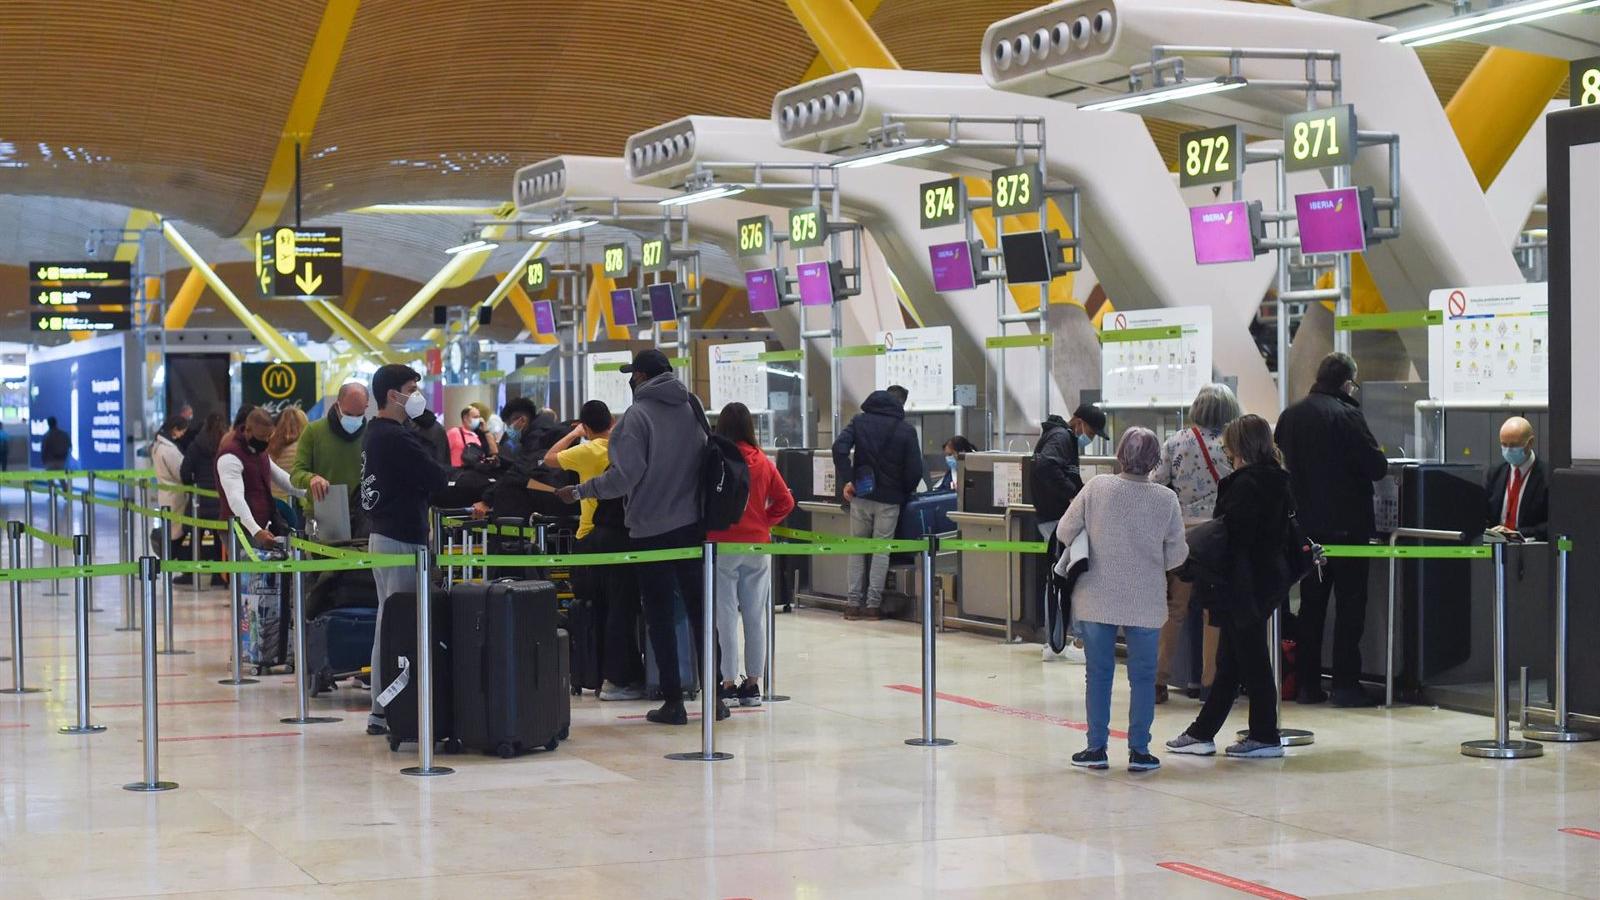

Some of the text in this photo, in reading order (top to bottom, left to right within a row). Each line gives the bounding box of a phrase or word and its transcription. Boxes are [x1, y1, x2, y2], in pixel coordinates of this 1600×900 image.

[1293, 116, 1339, 160] 871
[1186, 135, 1230, 176] 872
[925, 186, 955, 219] 874
[996, 173, 1030, 207] 873
[1202, 212, 1225, 224] IBERIA
[1309, 199, 1334, 211] IBERIA
[740, 222, 763, 250] 876
[792, 212, 817, 242] 875
[605, 248, 623, 272] 878
[643, 240, 662, 267] 877
[527, 262, 543, 285] 879
